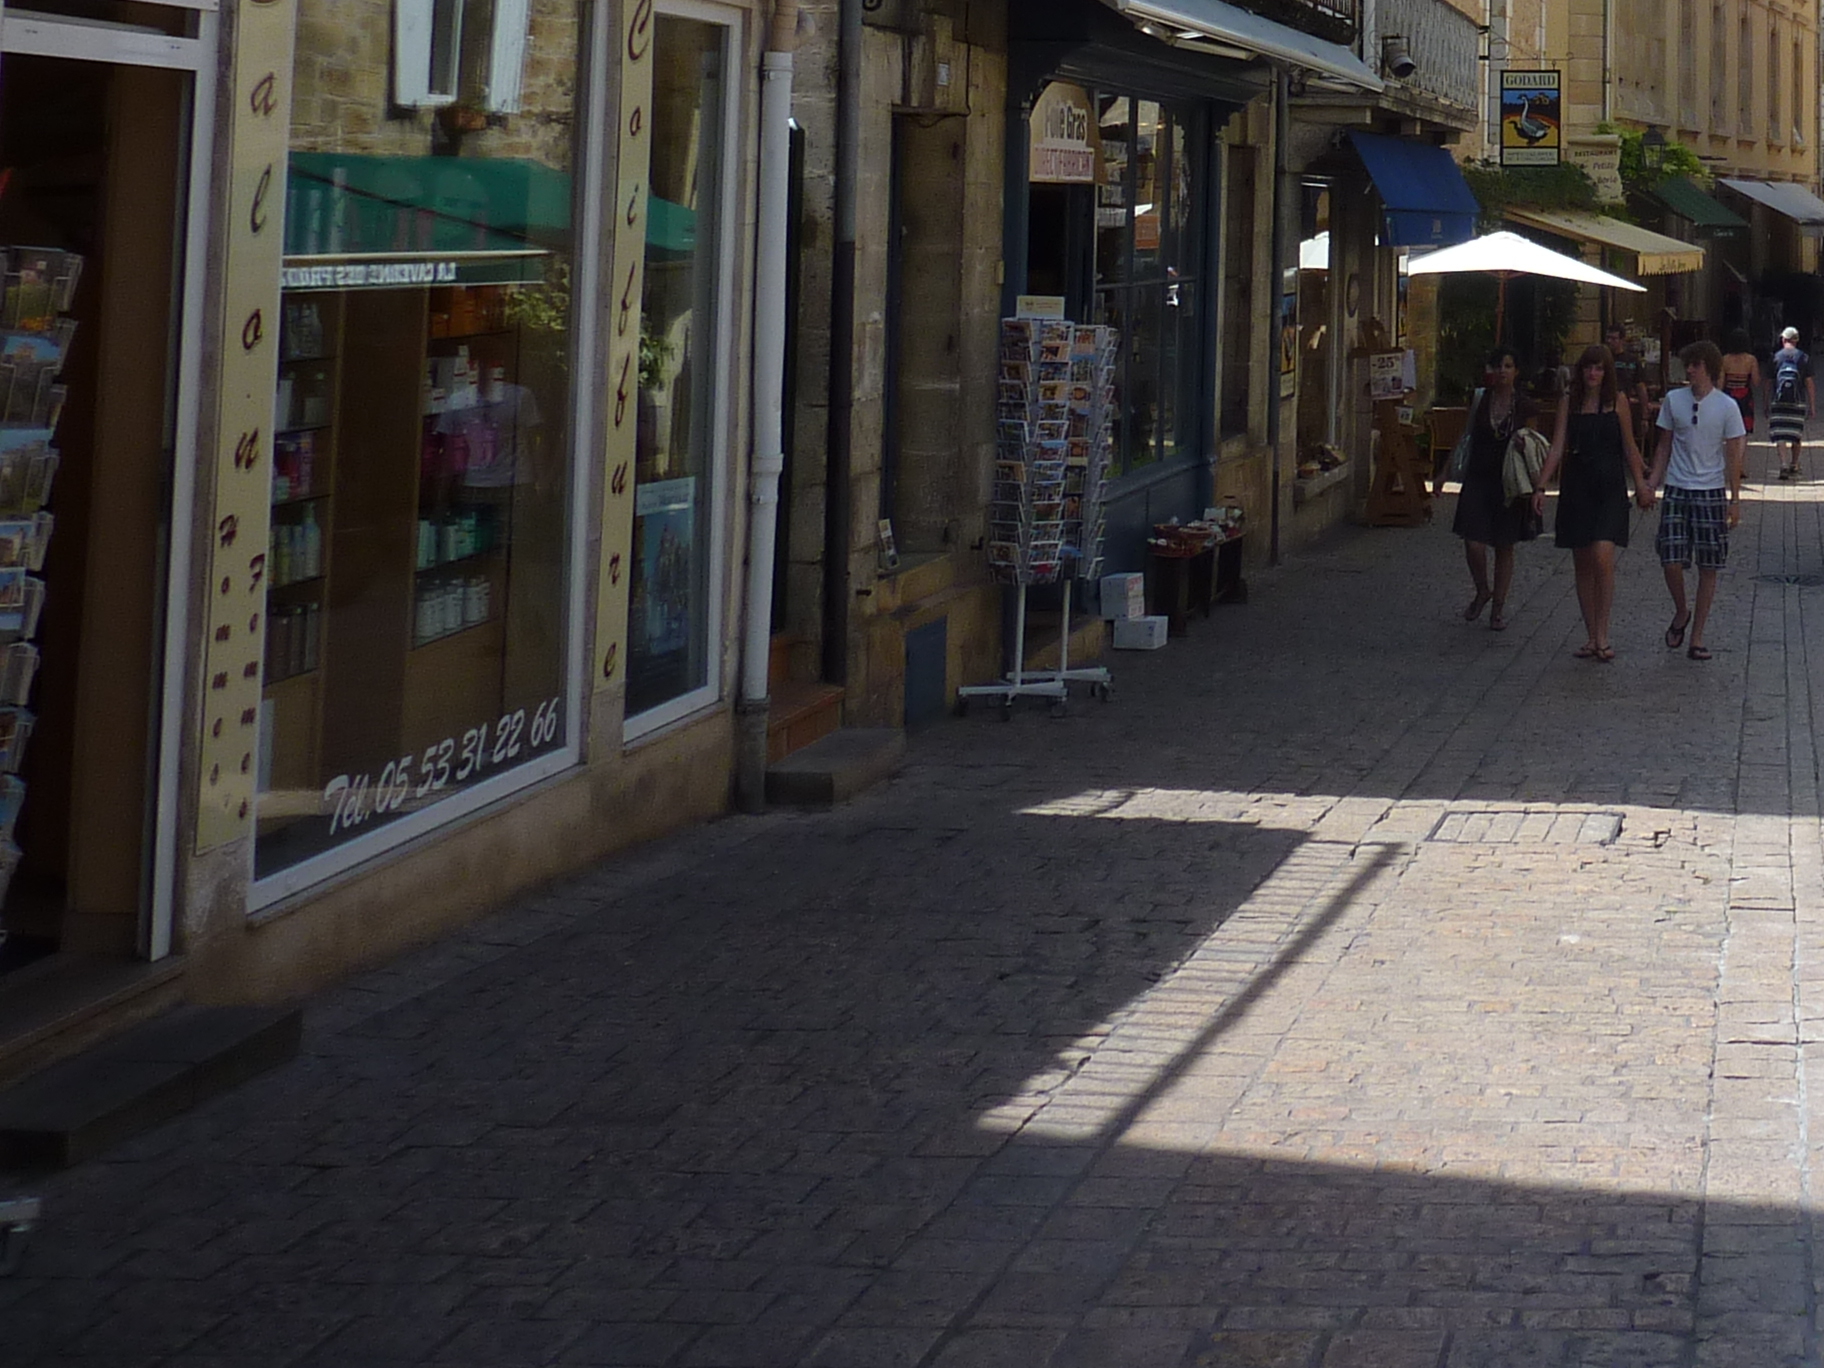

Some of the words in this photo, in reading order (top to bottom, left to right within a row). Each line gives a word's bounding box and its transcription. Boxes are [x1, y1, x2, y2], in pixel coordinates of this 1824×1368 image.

[1506, 75, 1555, 86] GODARD
[375, 754, 414, 814] 05
[415, 737, 455, 799] 53
[455, 721, 489, 781] 31
[492, 708, 526, 764] 22
[530, 695, 560, 749] 66
